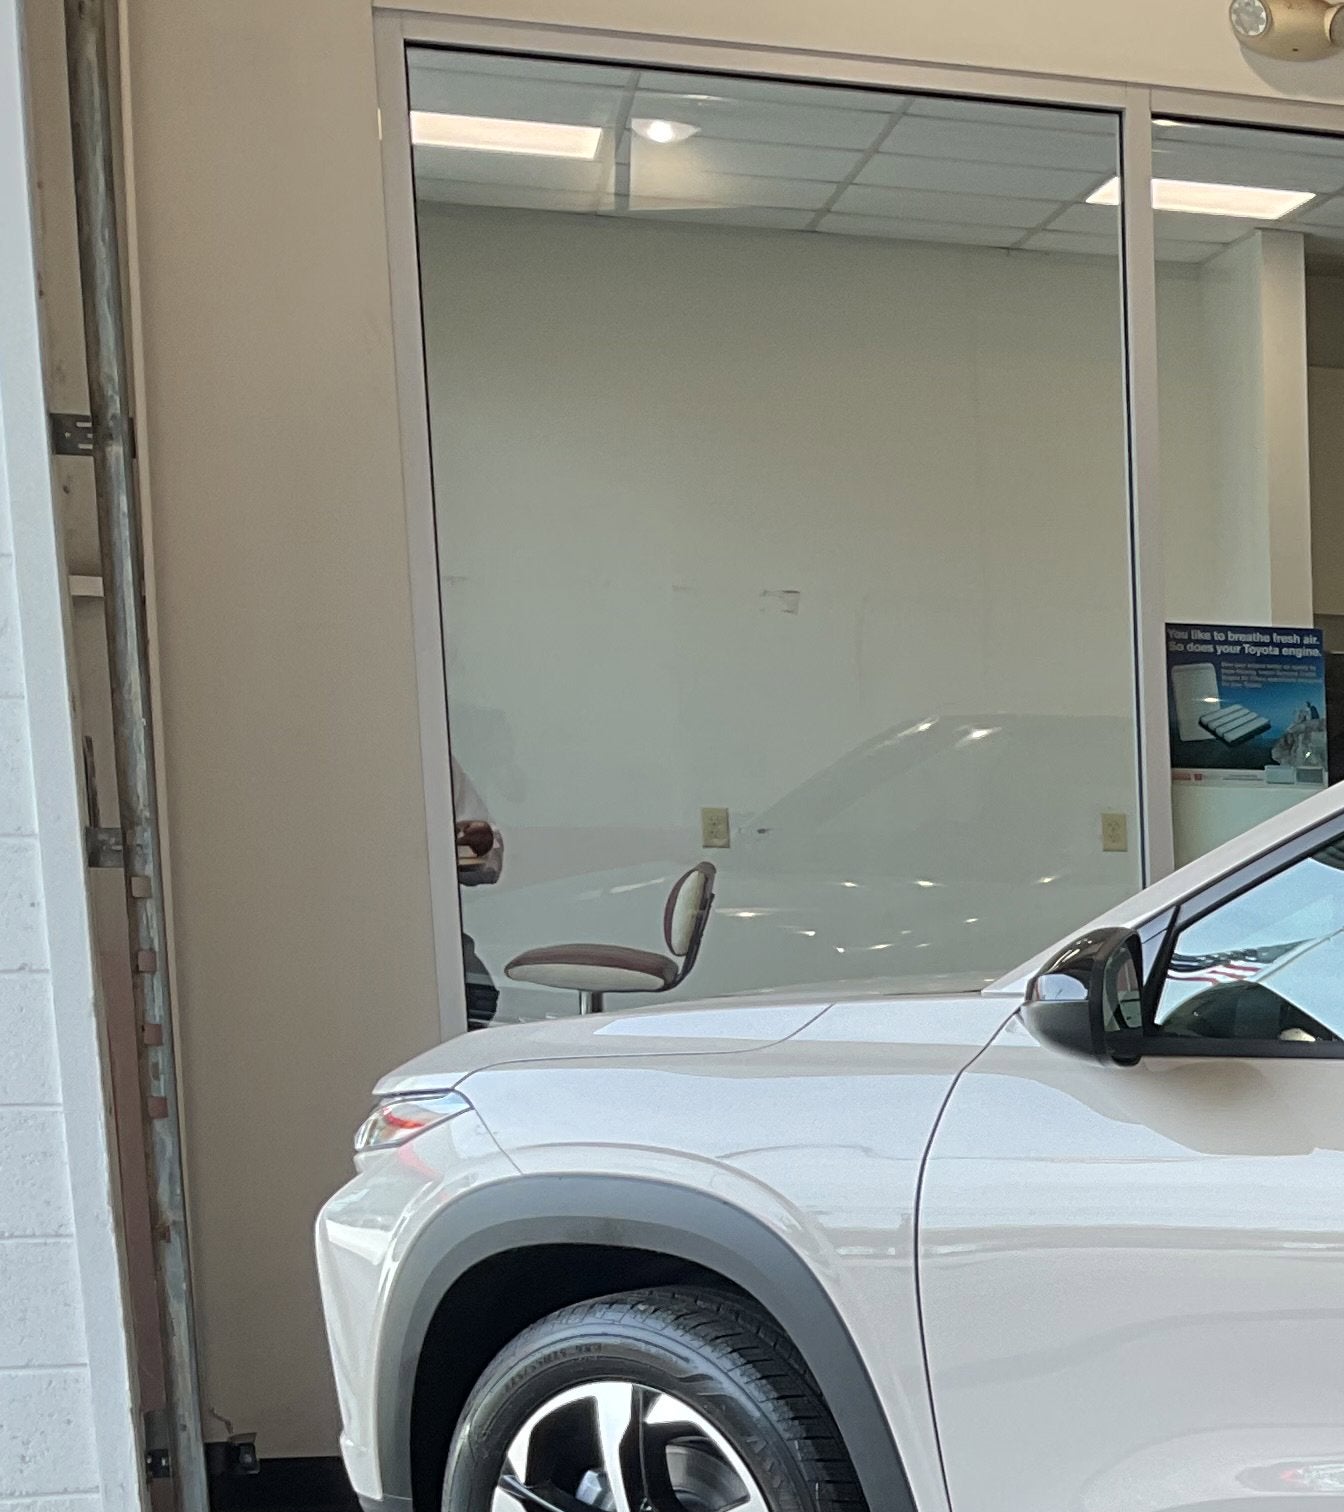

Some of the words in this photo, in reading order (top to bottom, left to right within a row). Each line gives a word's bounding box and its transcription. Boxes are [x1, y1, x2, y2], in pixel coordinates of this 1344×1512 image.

[1168, 628, 1188, 640] You
[1191, 629, 1211, 640] like
[1214, 631, 1226, 641] to
[1228, 631, 1270, 643] breathe
[1273, 632, 1300, 644] fresh
[1303, 634, 1320, 645] air.
[1168, 641, 1184, 652] So
[1186, 642, 1214, 653] does
[1216, 644, 1240, 655] your
[1243, 643, 1280, 656] Toyota
[1282, 646, 1322, 657] engine.
